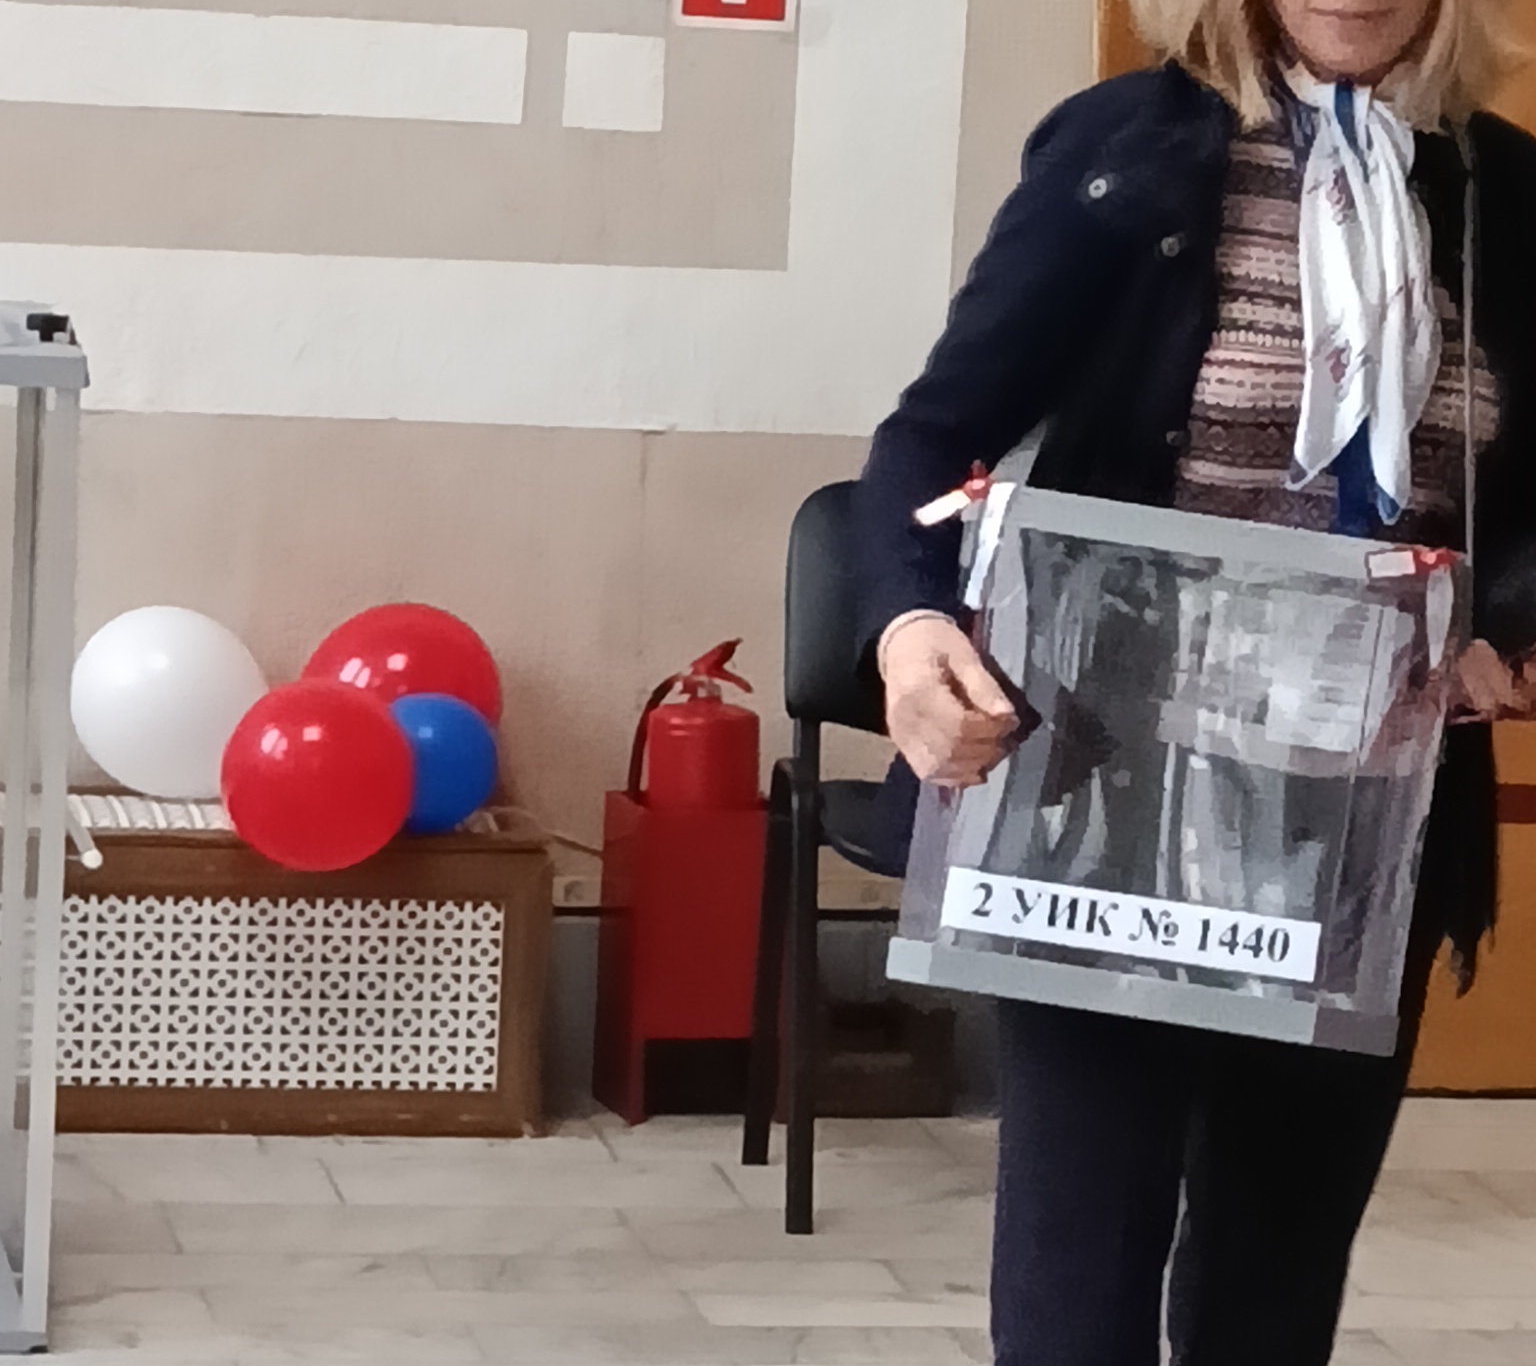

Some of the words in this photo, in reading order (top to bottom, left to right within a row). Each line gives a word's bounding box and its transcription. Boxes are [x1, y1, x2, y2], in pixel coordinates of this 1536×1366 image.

[971, 882, 994, 917] 2
[1011, 887, 1119, 937] УИК
[1127, 906, 1180, 947] №
[1197, 918, 1290, 963] 1440
